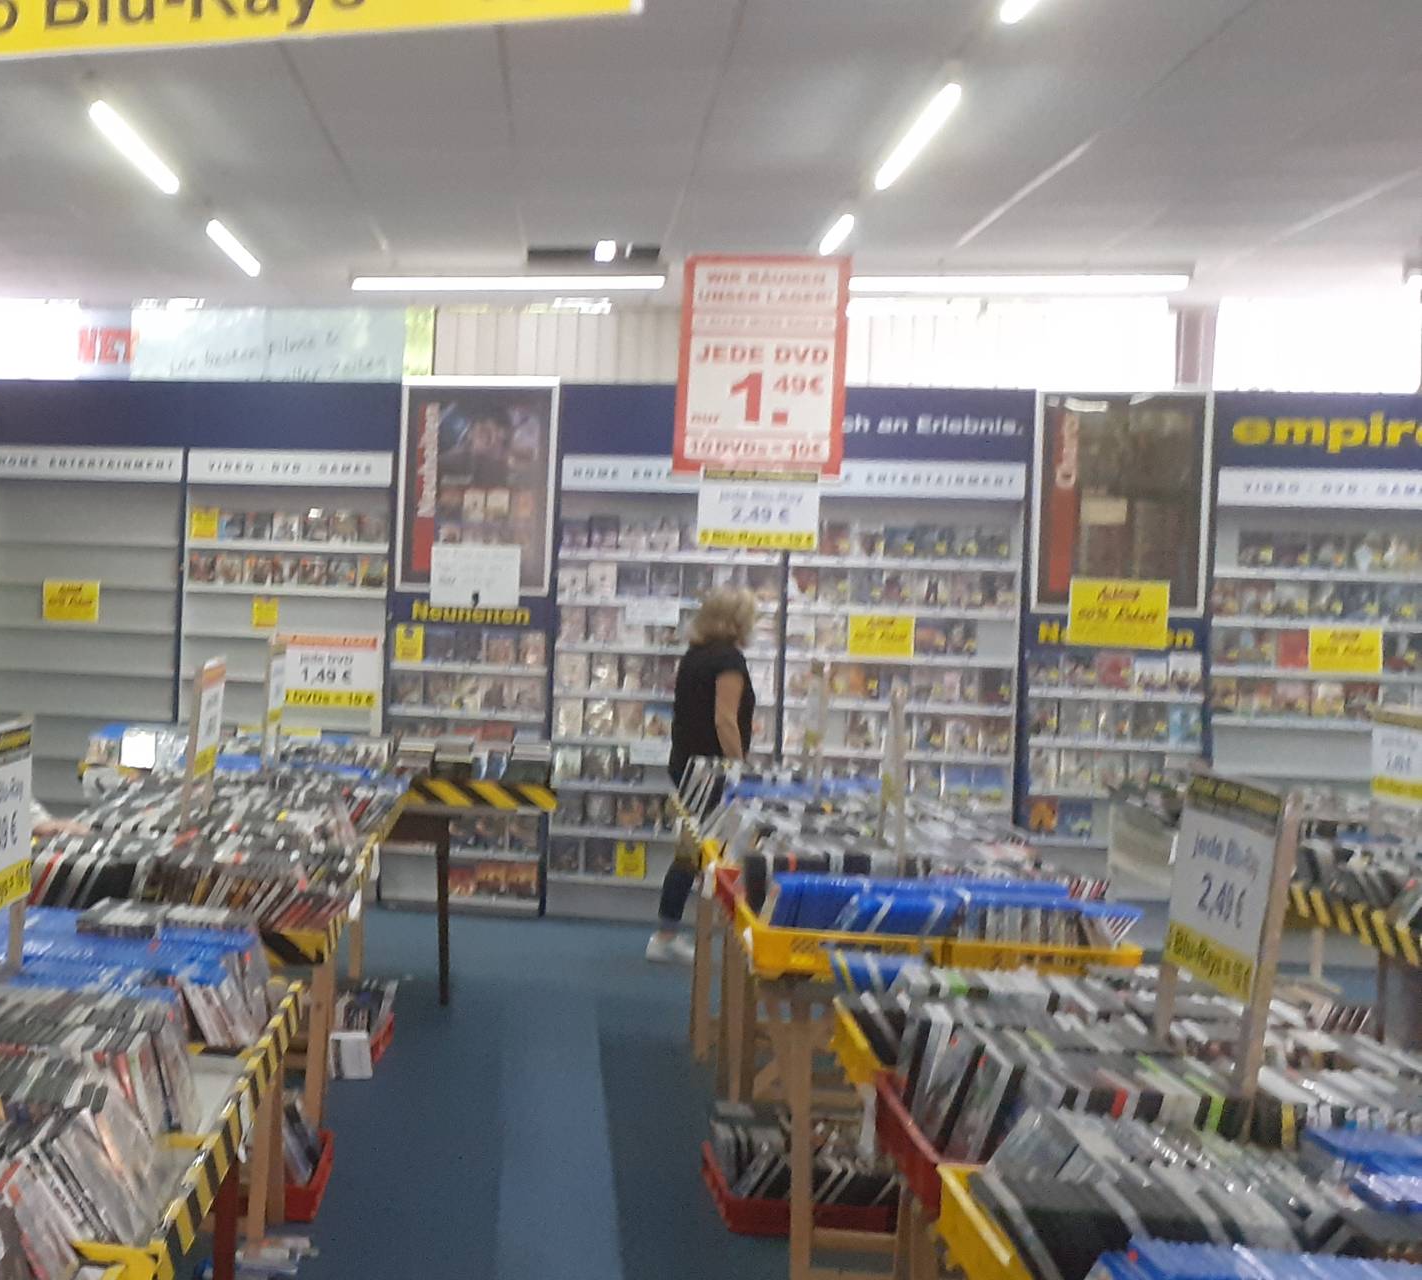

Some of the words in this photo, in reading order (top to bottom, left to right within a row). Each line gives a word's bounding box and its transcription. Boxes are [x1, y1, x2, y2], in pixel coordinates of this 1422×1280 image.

[697, 344, 764, 363] JEDE
[774, 345, 828, 364] DVD
[877, 416, 909, 434] an
[916, 412, 1024, 437] Erlebnis.
[1233, 410, 1422, 454] empir
[301, 667, 337, 685] 1,49
